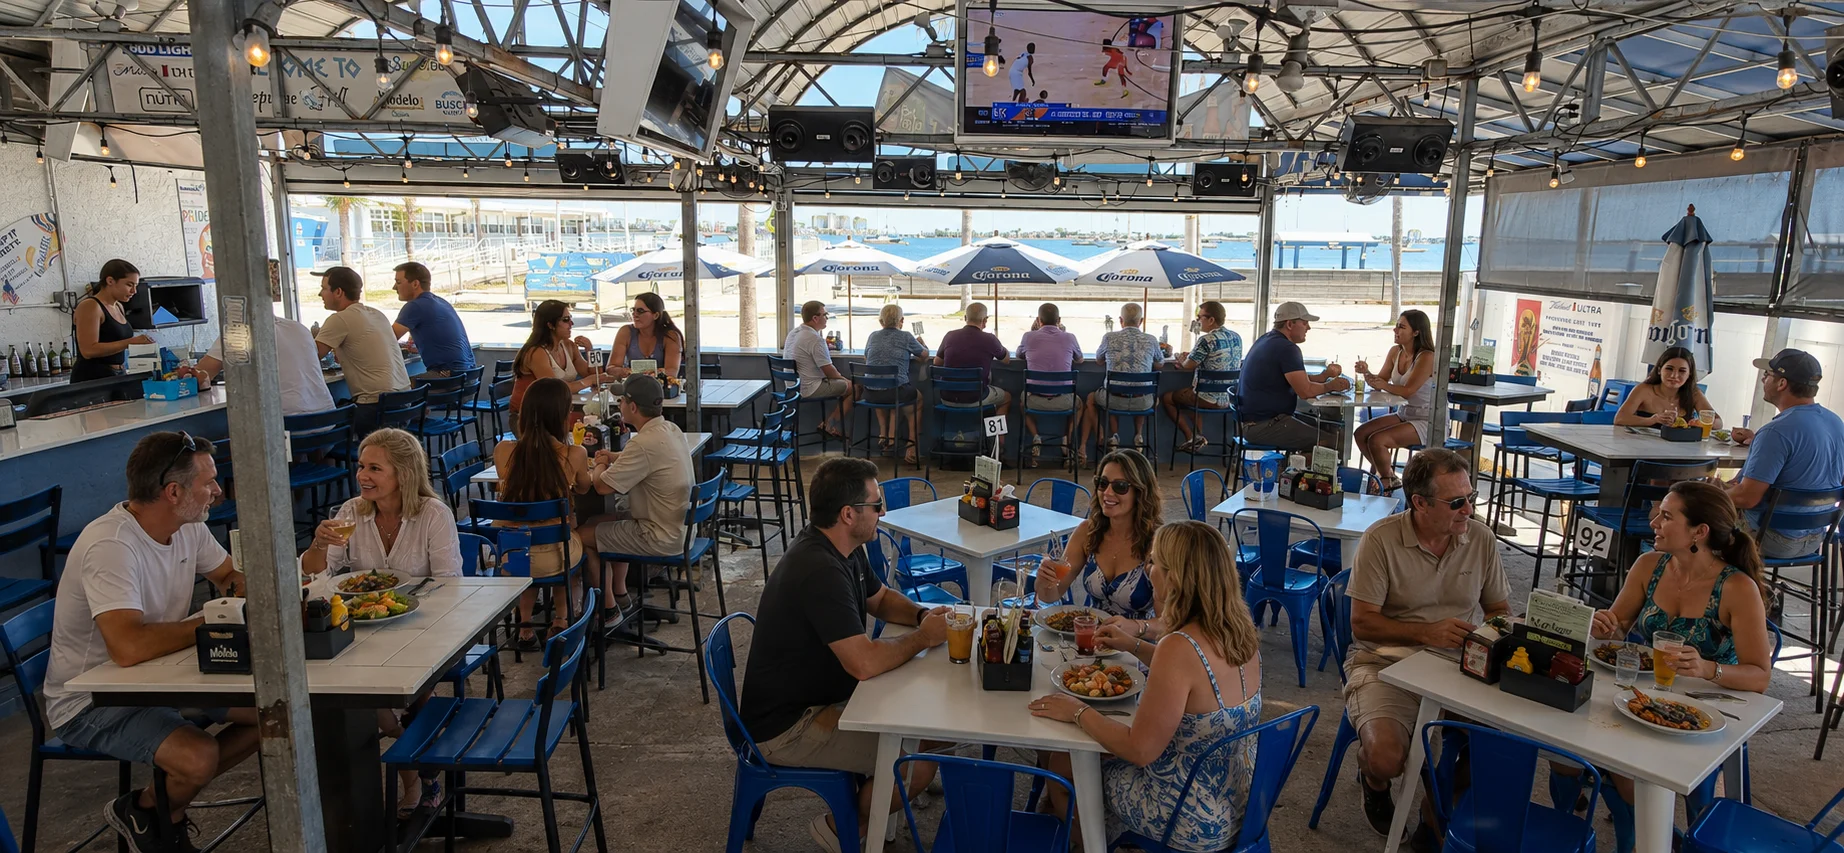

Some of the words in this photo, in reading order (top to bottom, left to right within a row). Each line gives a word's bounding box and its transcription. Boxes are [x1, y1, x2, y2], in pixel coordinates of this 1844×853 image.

[333, 57, 362, 79] TO
[182, 209, 209, 223] PRIDE
[822, 264, 880, 273] Corona
[971, 270, 1031, 281] Corona
[1096, 272, 1153, 283] Corona
[988, 418, 1004, 434] 81
[1579, 526, 1607, 552] 92
